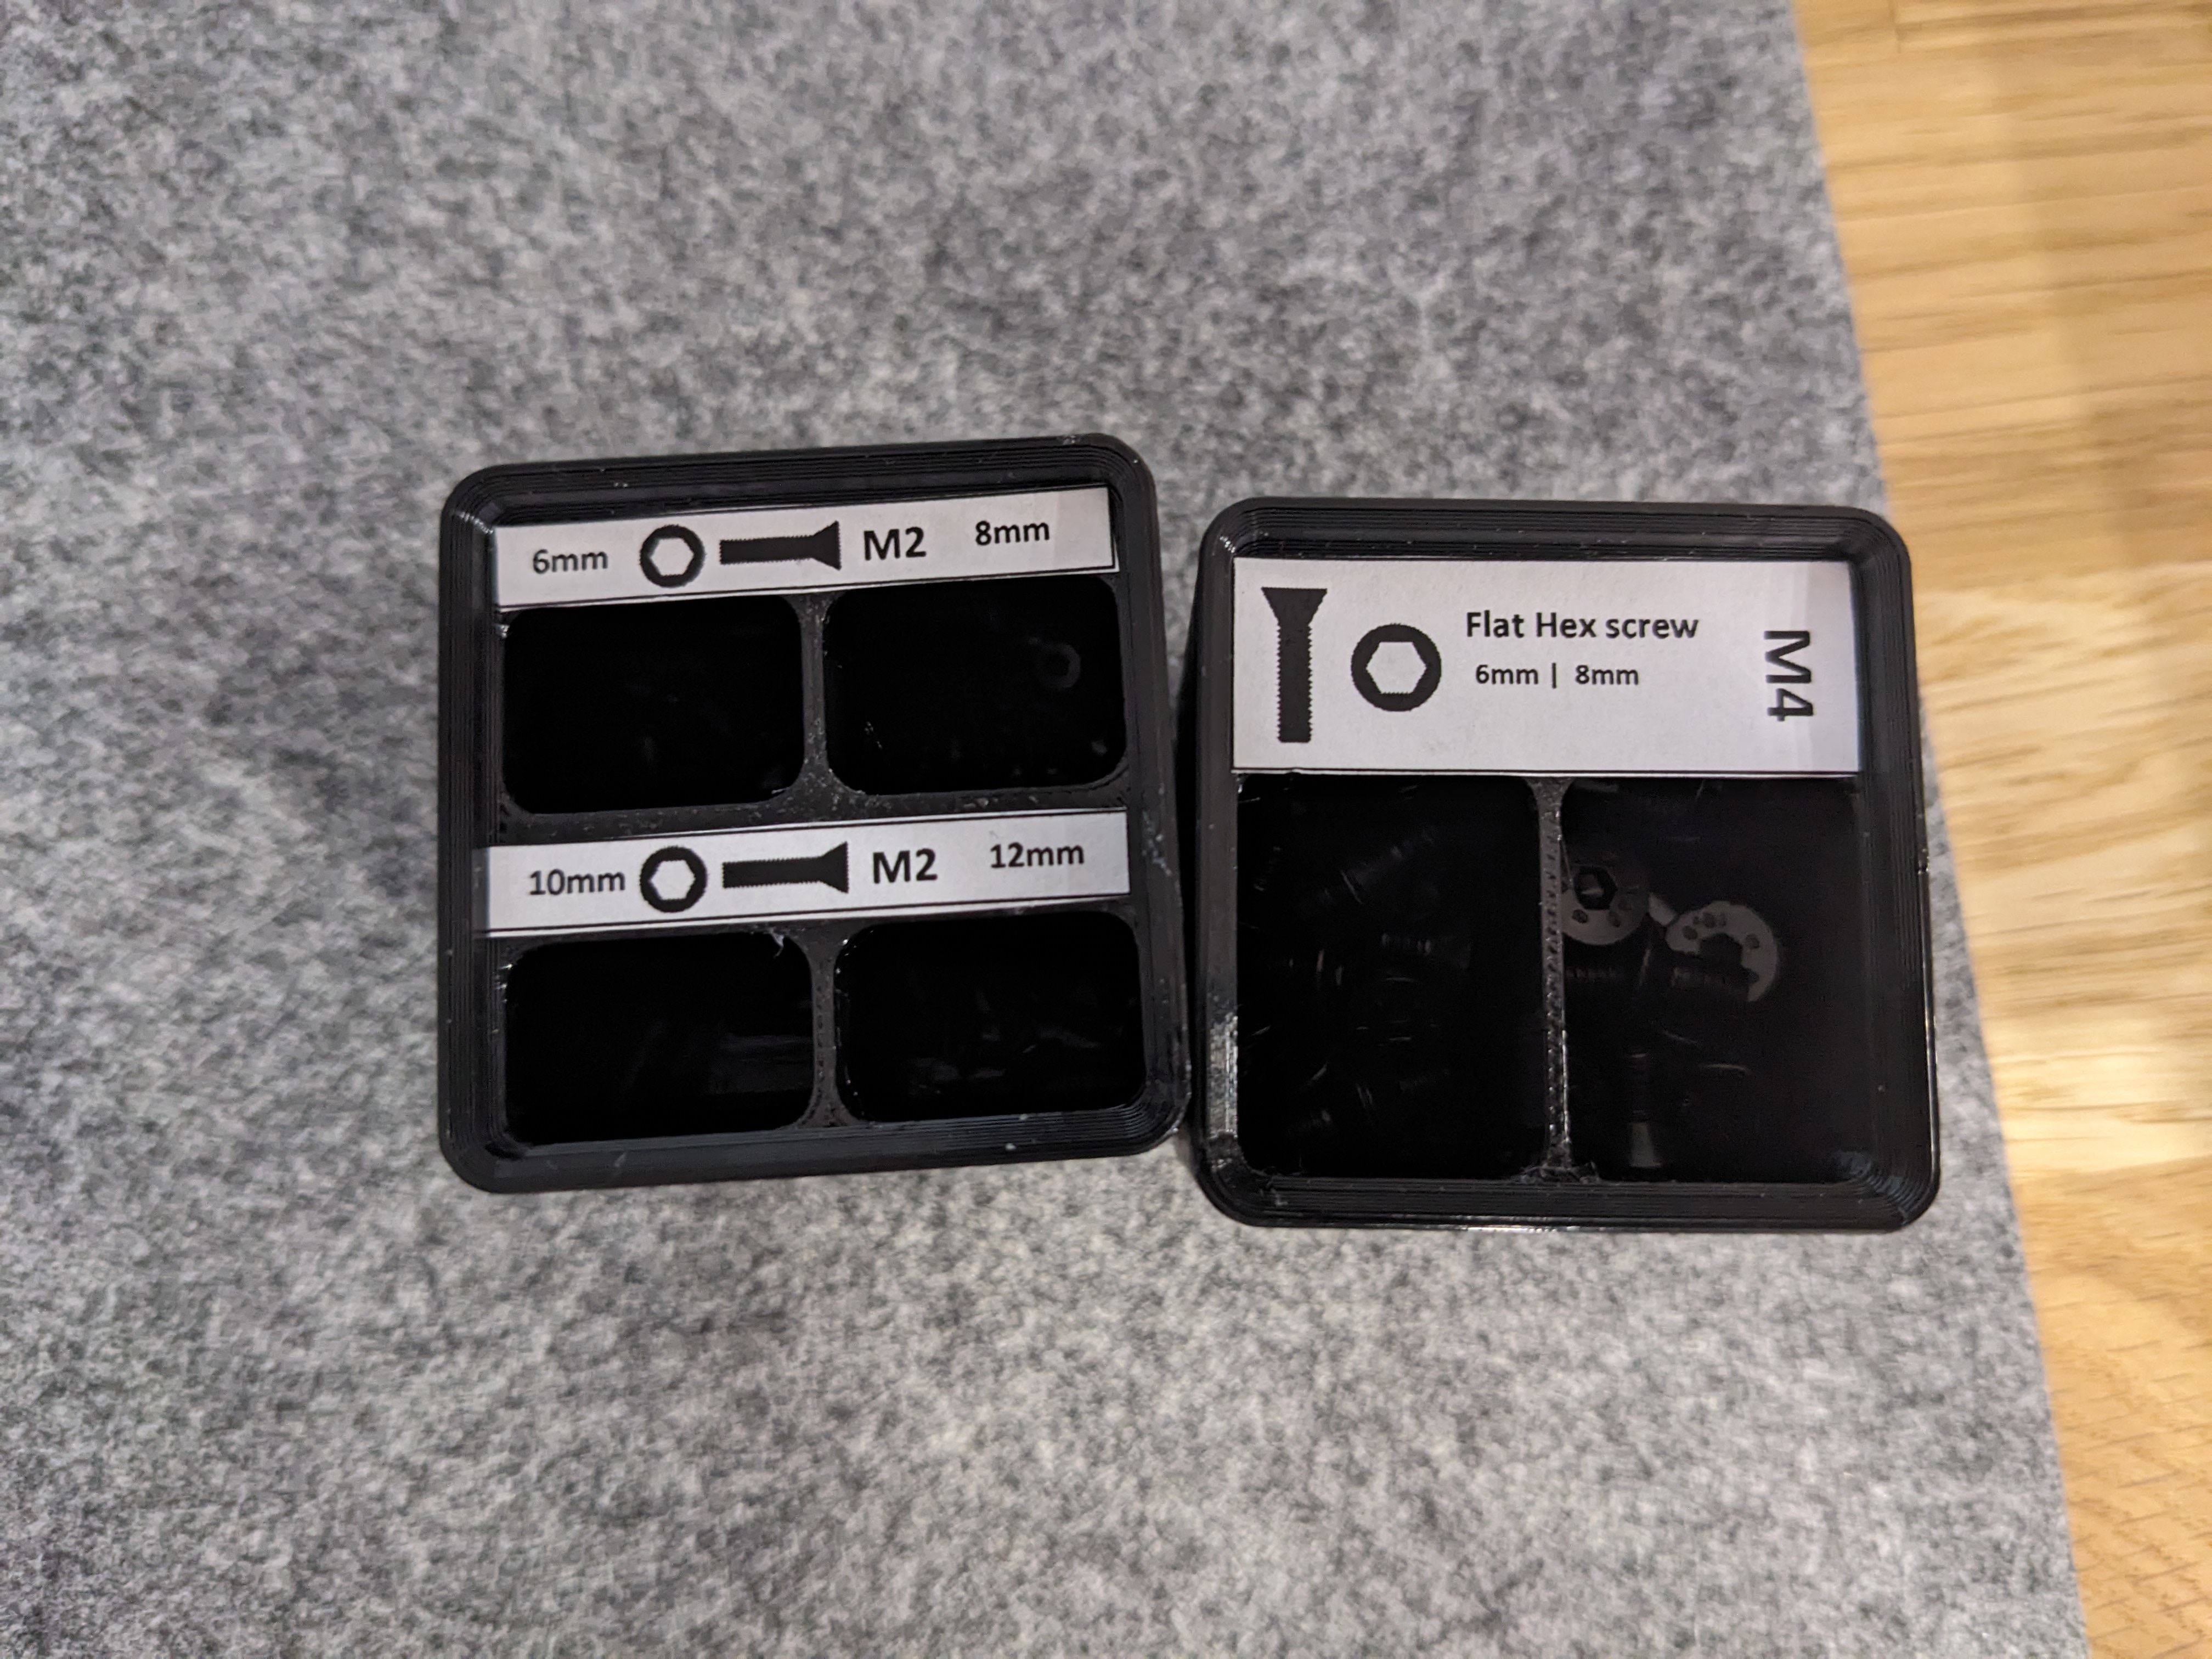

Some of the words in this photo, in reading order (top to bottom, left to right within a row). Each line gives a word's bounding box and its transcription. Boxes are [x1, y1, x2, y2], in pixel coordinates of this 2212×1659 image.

[864, 526, 927, 561] M2
[975, 520, 1051, 546] 8mm
[533, 549, 608, 574] 6mm
[1467, 610, 1525, 639] Flat
[1536, 612, 1597, 639] Hex
[1606, 619, 1699, 639] screw
[1476, 664, 1539, 685] 6mm
[1575, 665, 1639, 685] 8mm
[1765, 630, 1815, 722] M4
[873, 848, 938, 884] M2
[990, 842, 1085, 869] 12mm
[530, 869, 625, 896] 10mm
